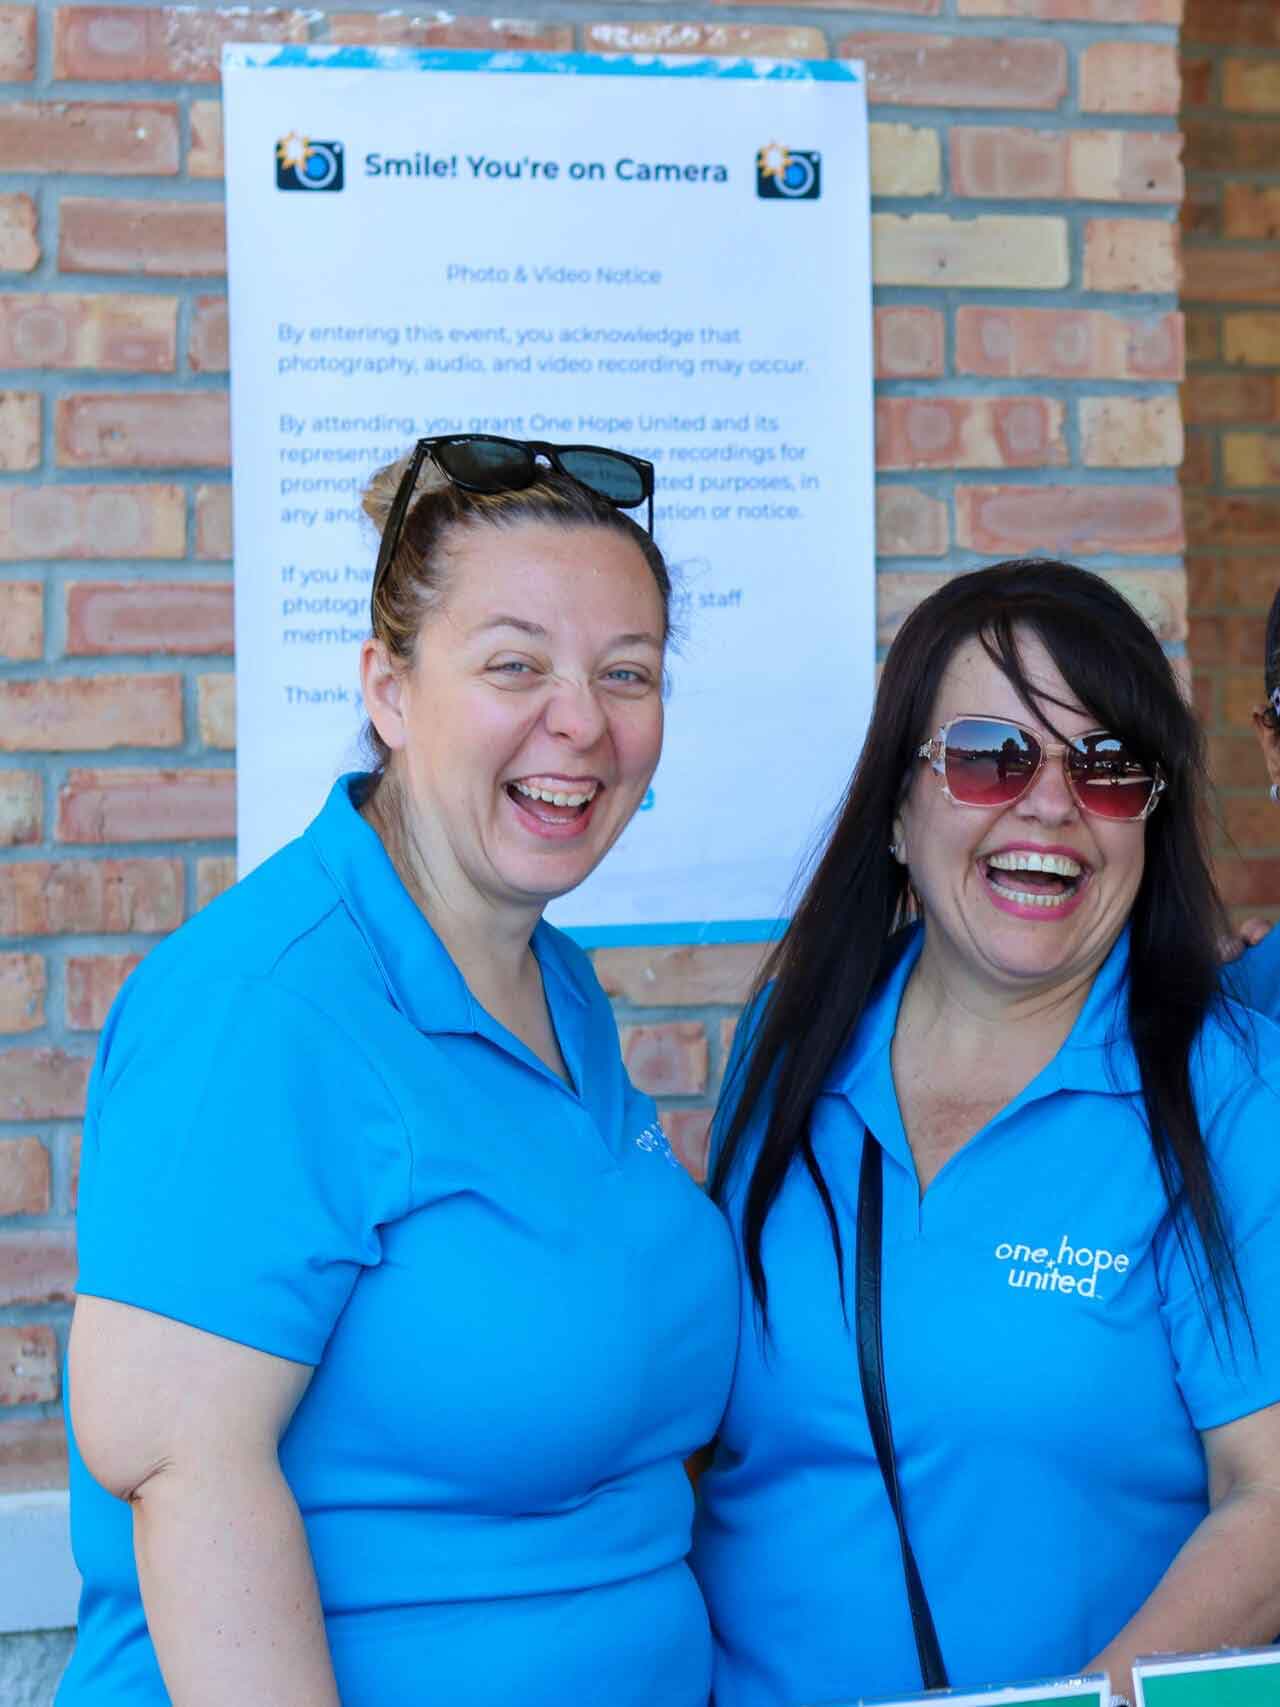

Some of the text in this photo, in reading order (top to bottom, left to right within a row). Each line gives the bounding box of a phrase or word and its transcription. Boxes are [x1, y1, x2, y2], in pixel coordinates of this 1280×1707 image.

[365, 153, 729, 183] Smile! You're on Camera
[447, 264, 663, 286] Photo & Video Notice
[278, 323, 303, 345] By
[309, 324, 400, 346] entering
[405, 325, 443, 343] this
[517, 327, 553, 346] you
[559, 326, 695, 348] acknowledge
[700, 327, 742, 344] that
[278, 353, 418, 376] photography,
[492, 354, 531, 373] and
[538, 354, 592, 373] video
[598, 354, 694, 377] recording
[701, 358, 742, 377] may
[750, 357, 809, 375] occur.
[280, 414, 305, 436] By
[425, 418, 462, 436] you
[468, 415, 524, 436] grant
[529, 414, 572, 433] One
[578, 415, 632, 436] Hope
[640, 414, 707, 433] United
[712, 414, 749, 433] and
[755, 415, 780, 433] its
[670, 444, 776, 465] recordings
[781, 444, 807, 460] for
[801, 474, 820, 490] in
[281, 508, 319, 527] any
[712, 506, 731, 520] or
[282, 565, 294, 583] If
[300, 567, 339, 587] you
[699, 588, 743, 608] staff
[286, 685, 347, 704] Thank
[995, 1235, 1129, 1272] one hope
[1008, 1267, 1095, 1298] united
